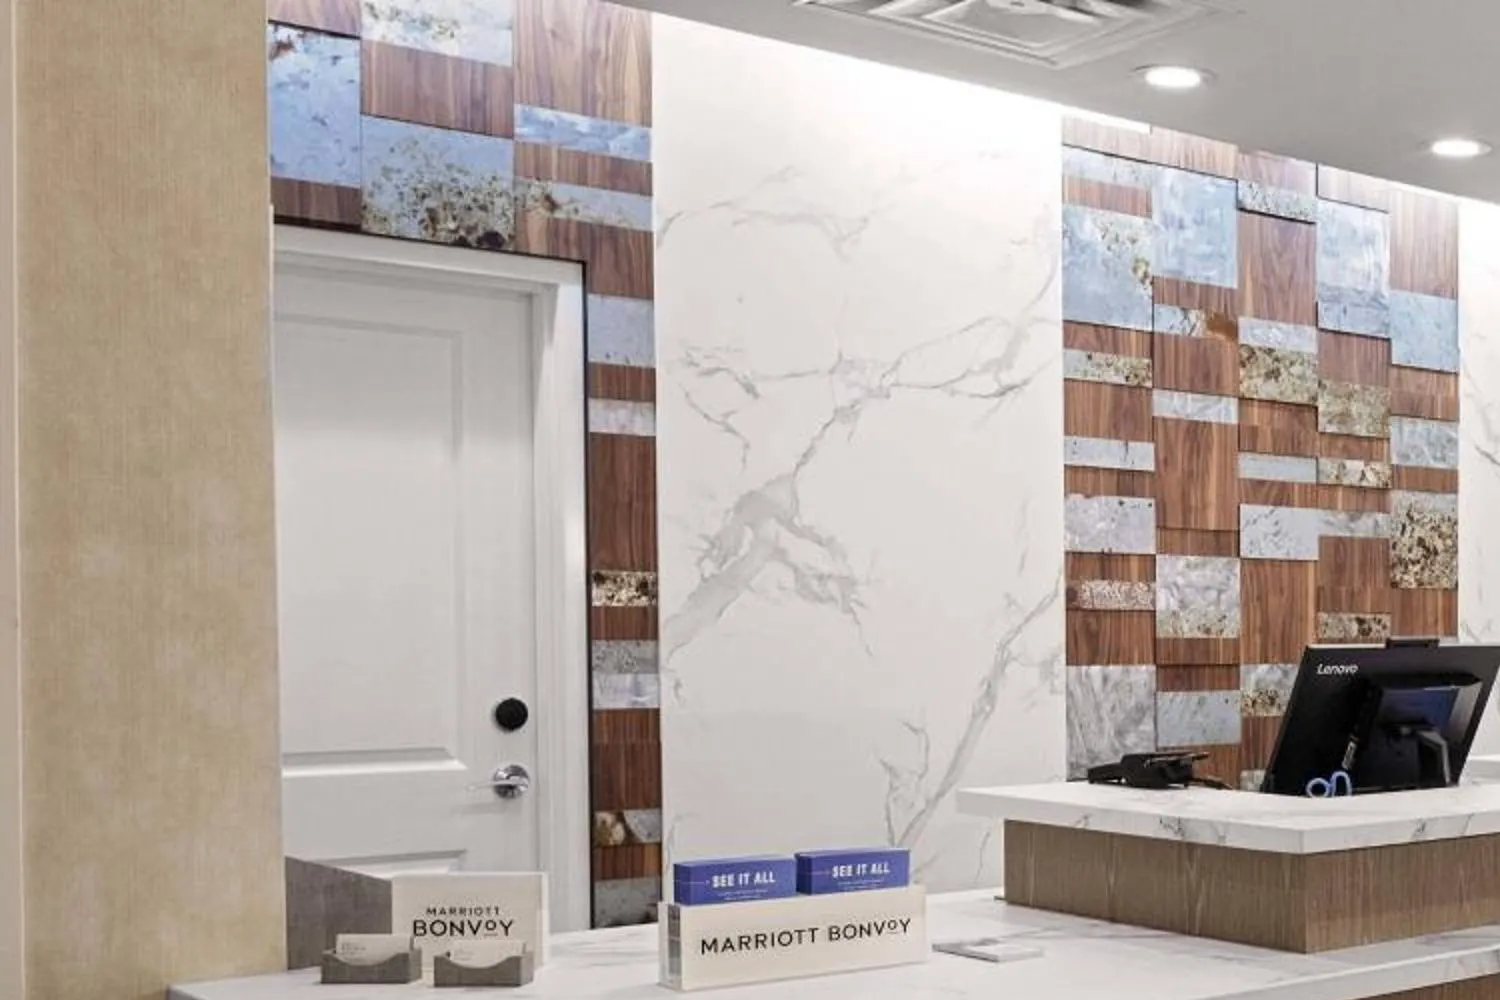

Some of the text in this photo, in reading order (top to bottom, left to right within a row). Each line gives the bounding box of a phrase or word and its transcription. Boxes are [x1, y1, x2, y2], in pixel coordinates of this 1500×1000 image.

[1316, 663, 1359, 676] Lenovo
[832, 861, 891, 878] SEE IT ALL
[712, 871, 776, 888] SEE IT ALL
[426, 905, 500, 916] MARRIOTT
[701, 927, 819, 955] MARRIOTT
